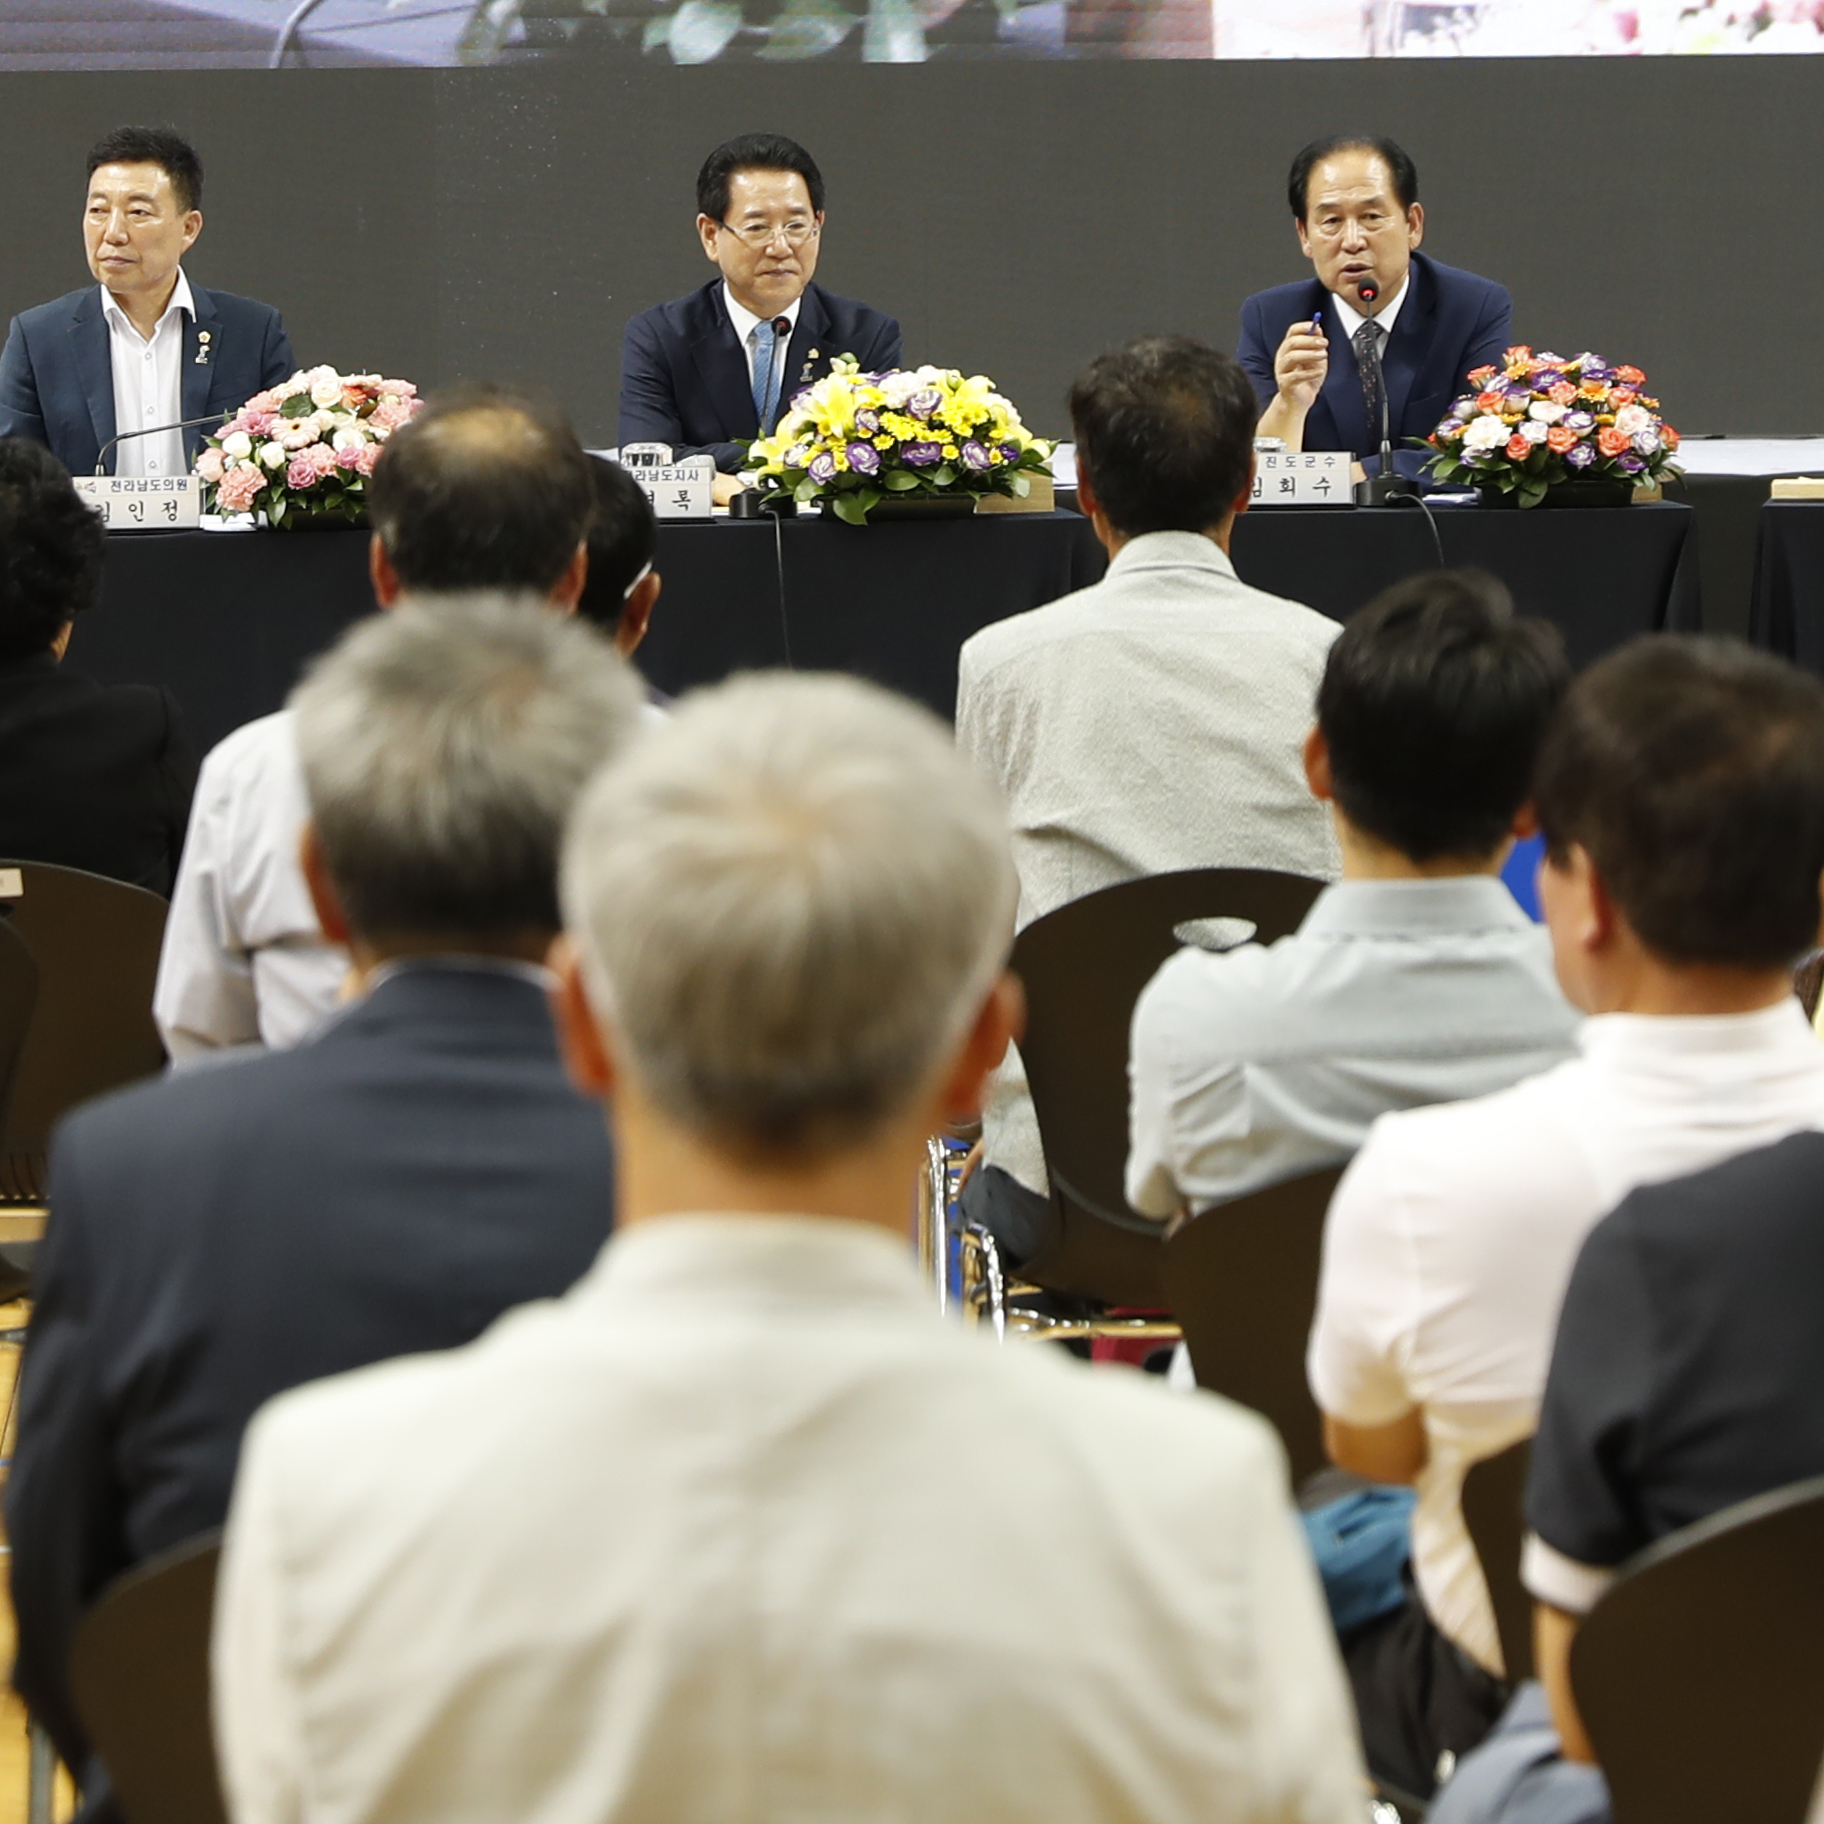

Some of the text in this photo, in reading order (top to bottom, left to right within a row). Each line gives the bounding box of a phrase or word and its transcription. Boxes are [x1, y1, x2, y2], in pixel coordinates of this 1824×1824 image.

[1265, 455, 1336, 469] 진도군수
[635, 468, 700, 482] 라남도지사
[110, 478, 188, 493] 전라남도의원
